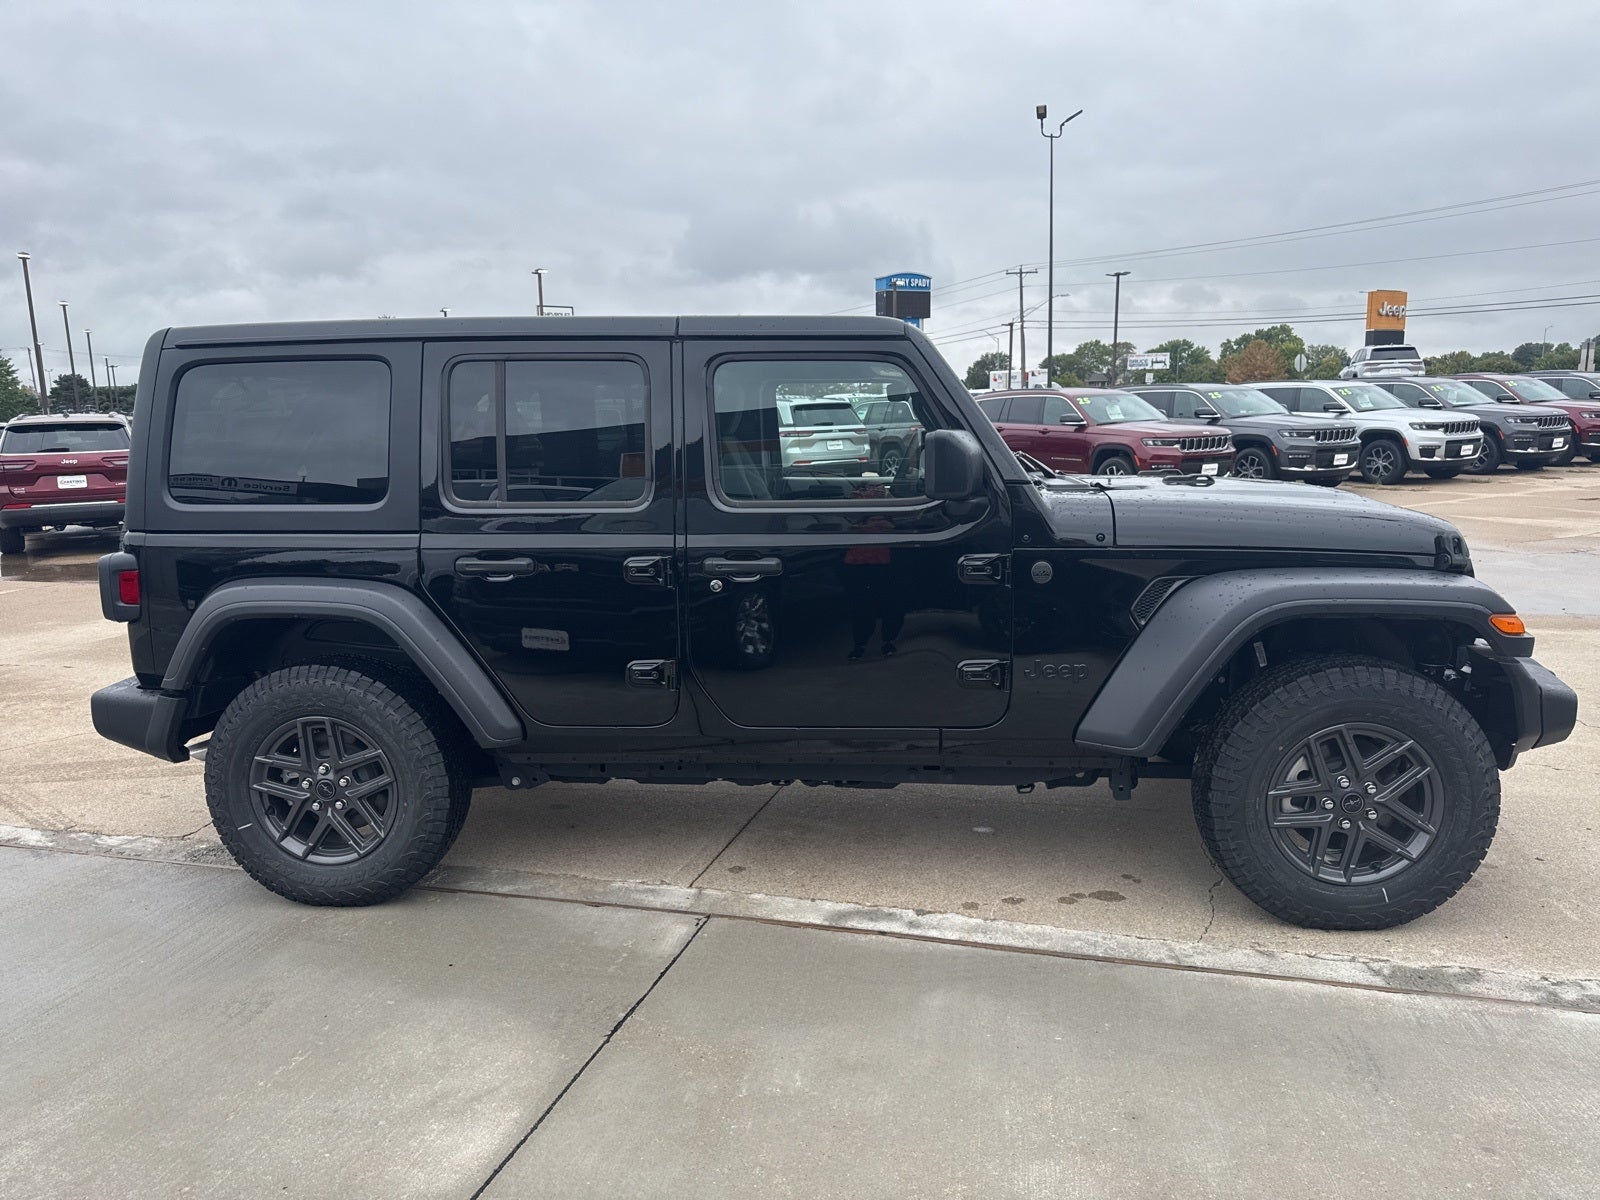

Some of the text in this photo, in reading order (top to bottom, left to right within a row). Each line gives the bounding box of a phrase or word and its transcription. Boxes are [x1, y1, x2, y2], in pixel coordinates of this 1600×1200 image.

[891, 277, 930, 287] JRY SPADY
[1379, 301, 1406, 319] Jeep
[1208, 391, 1223, 399] 25
[1338, 388, 1352, 396] 25
[1076, 397, 1091, 405] 25
[1024, 659, 1088, 684] Jeep
